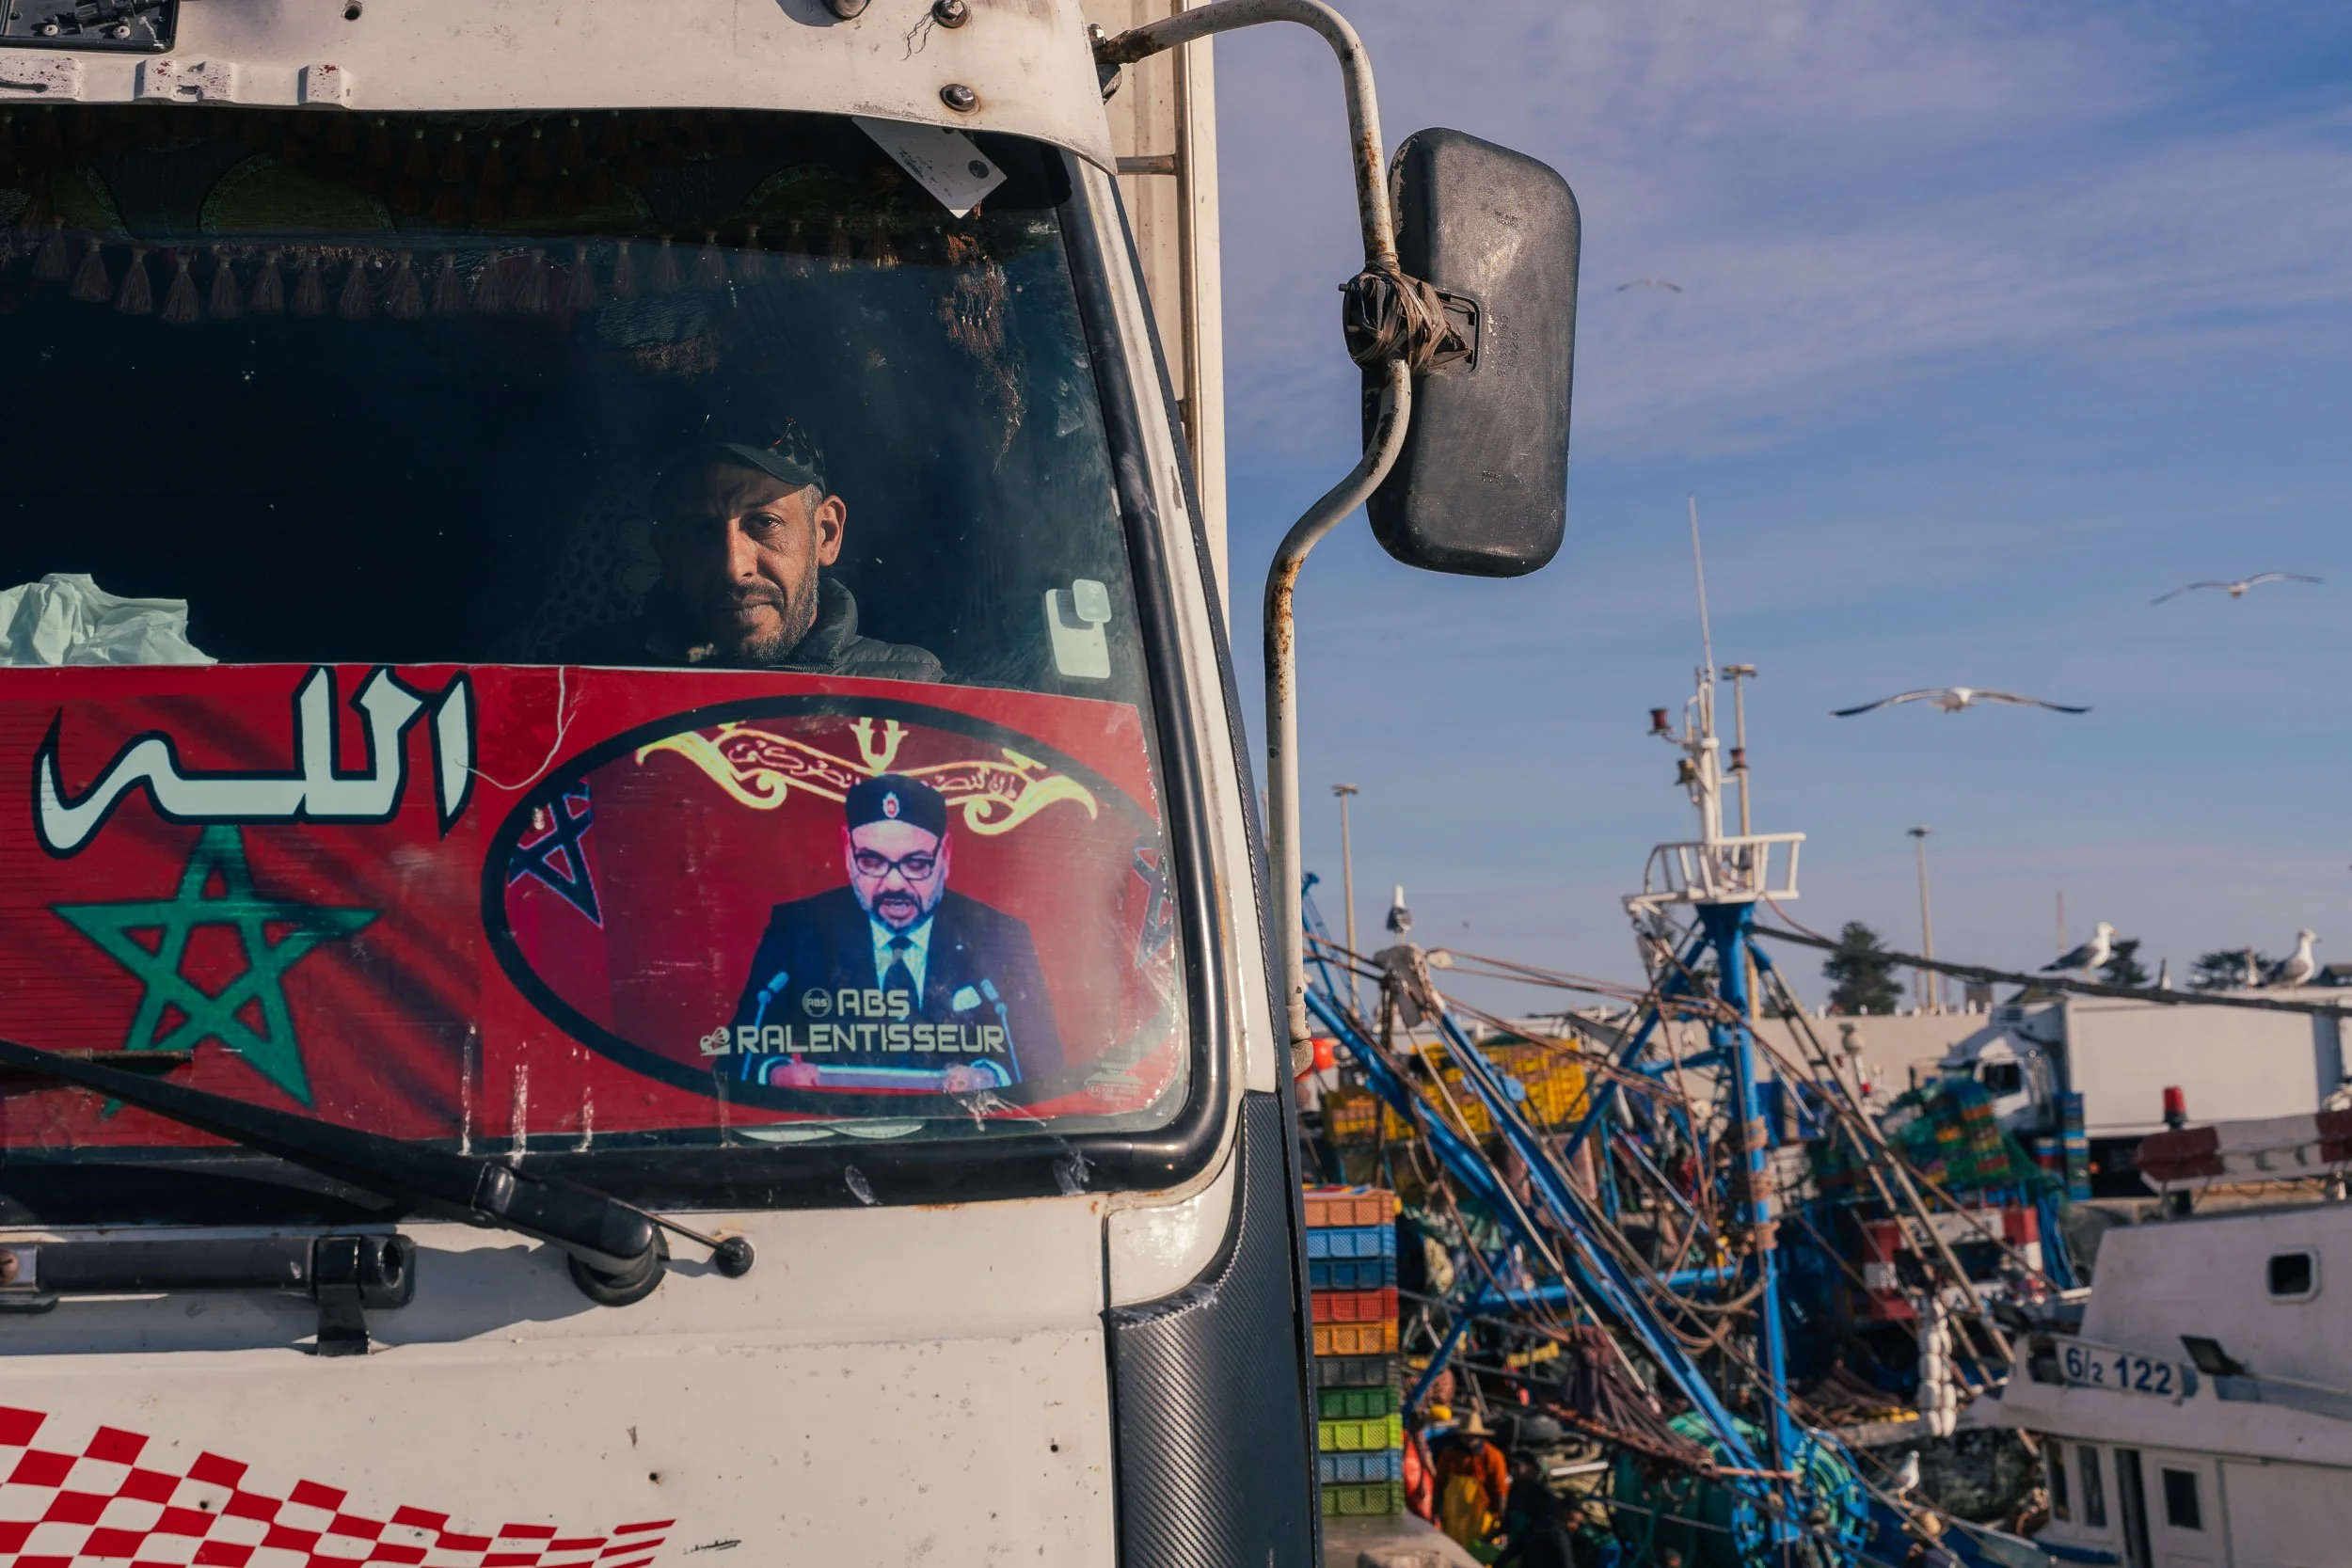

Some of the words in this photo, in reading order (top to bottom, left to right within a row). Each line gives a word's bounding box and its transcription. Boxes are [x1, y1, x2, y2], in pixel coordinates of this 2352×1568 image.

[36, 665, 477, 855] الله
[837, 989, 910, 1017] ABS
[737, 1024, 1005, 1053] RALENTISSEUR
[2066, 1347, 2104, 1383] 6/2
[2114, 1355, 2172, 1395] 122
